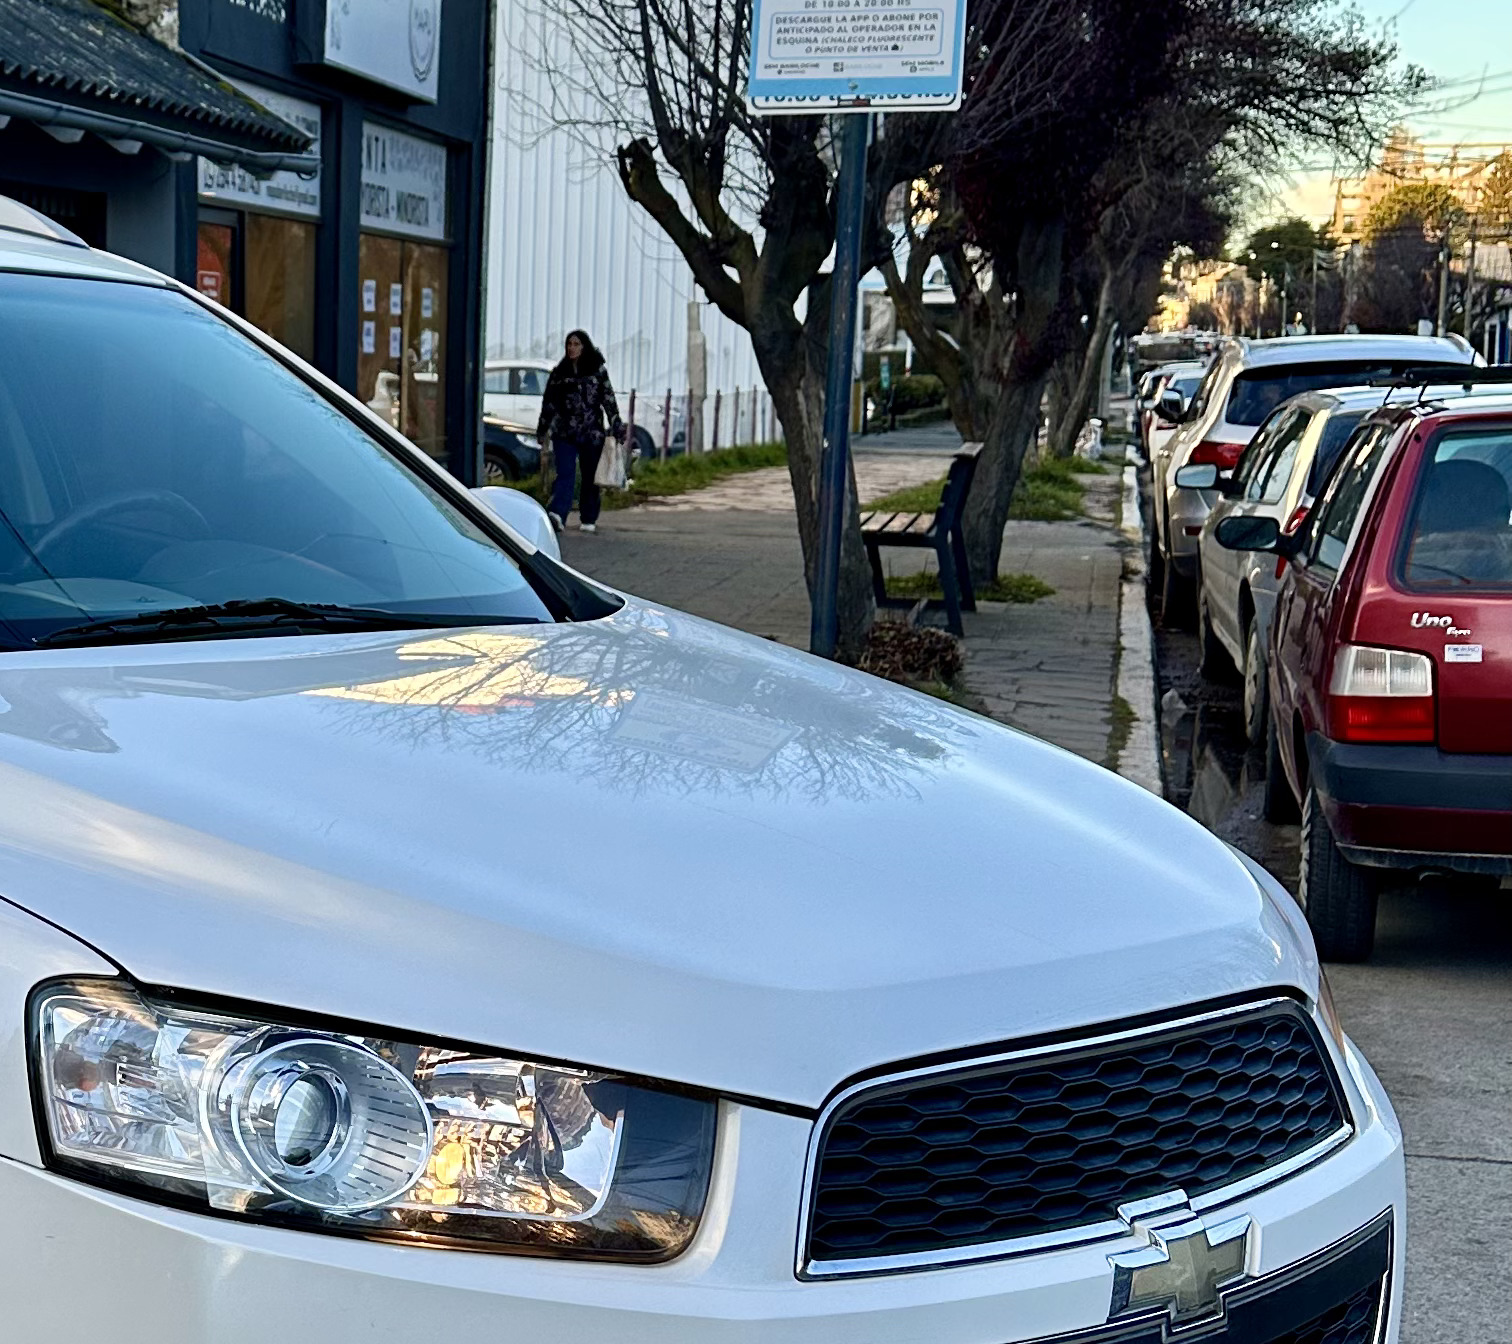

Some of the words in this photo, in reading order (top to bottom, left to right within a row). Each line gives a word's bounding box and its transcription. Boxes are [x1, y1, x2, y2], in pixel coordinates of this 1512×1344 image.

[804, 0, 818, 9] DE
[854, 0, 861, 7] A
[775, 15, 831, 25] DESCARGUE
[835, 14, 847, 23] LA
[850, 13, 870, 23] APP
[872, 13, 880, 22] O
[882, 12, 916, 22] ABONE
[918, 11, 939, 21] POR
[776, 25, 834, 35] ANTICIPADO
[837, 25, 848, 33] AL
[851, 23, 905, 33] OPERADOR
[908, 23, 920, 32] EN
[924, 22, 936, 31] LA
[776, 35, 819, 46] ESQUINA
[805, 45, 813, 54] O
[814, 44, 845, 53] PUNTO
[847, 44, 859, 53] DE
[861, 43, 889, 52] VENTA
[1411, 613, 1452, 627] Uno
